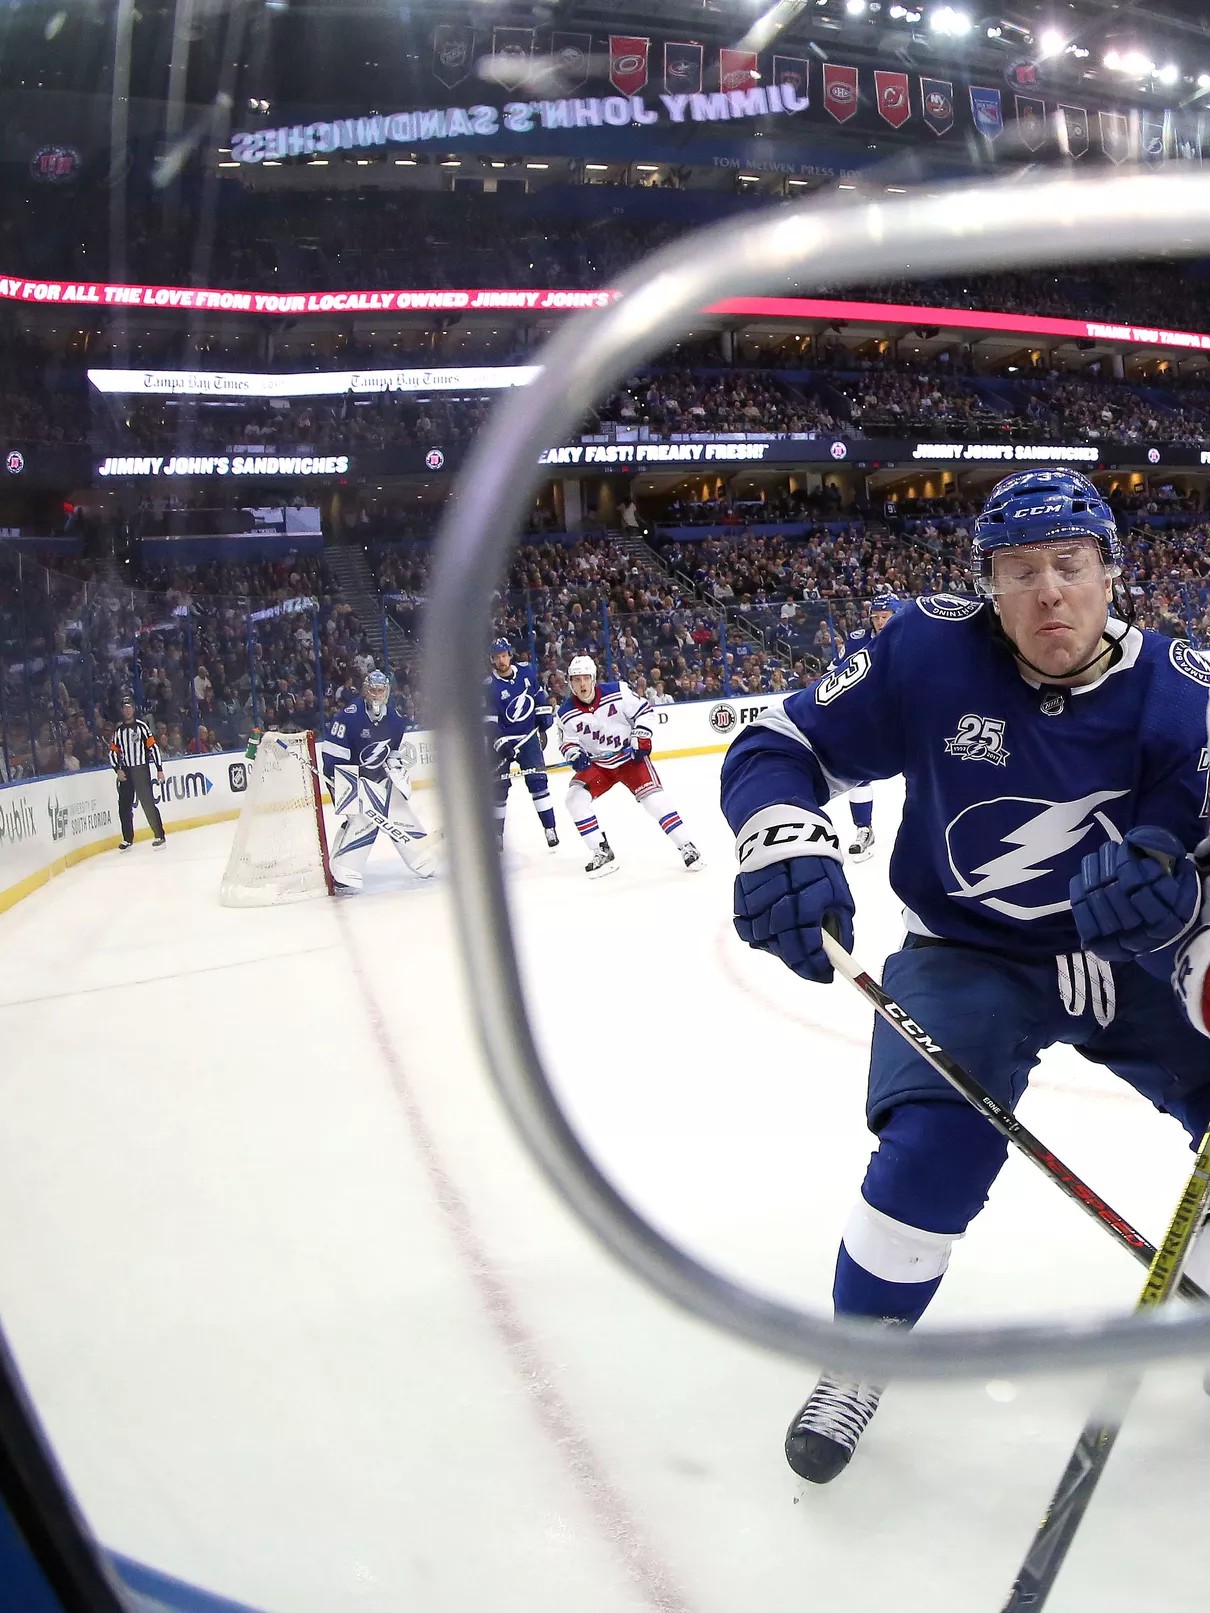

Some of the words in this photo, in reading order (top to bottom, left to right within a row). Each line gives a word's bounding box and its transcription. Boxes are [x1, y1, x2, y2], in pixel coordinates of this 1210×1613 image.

[713, 156, 741, 168] TOM
[801, 165, 835, 177] PRESS
[0, 278, 22, 297] AY
[22, 283, 61, 301] FOR
[61, 285, 99, 302] ALL
[103, 287, 141, 304] THE
[143, 289, 192, 307] LOVE
[195, 292, 250, 310] FROM
[254, 295, 306, 313] YOUR
[307, 294, 395, 311] LOCALLY
[396, 292, 469, 309] OWNED
[470, 292, 542, 308] JIMMY
[541, 291, 609, 308] JOHN'S
[1086, 323, 1131, 341] THANK
[1132, 327, 1159, 343] YOU
[1160, 331, 1200, 348] TAMPA
[142, 373, 185, 394] Tampa
[187, 373, 212, 392] Bay
[213, 375, 250, 391] Times
[350, 373, 393, 392] Tampa
[395, 373, 421, 390] Bay
[422, 373, 460, 388] Times
[538, 446, 584, 464] EAKY
[584, 444, 635, 463] FAST!
[636, 443, 704, 462] FREAKY
[704, 442, 769, 460] FRESH!
[912, 444, 962, 460] JIMMY
[963, 444, 1014, 460] JOHN'S
[1014, 443, 1099, 462] SANDWICHES
[99, 456, 164, 476] JIMMY
[163, 456, 230, 475] JOHN'S
[231, 455, 349, 475] SANDWICHES
[1013, 504, 1062, 519] CCM
[524, 678, 531, 688] A
[607, 703, 618, 718] A
[330, 721, 347, 739] 88
[955, 713, 1006, 753] 25
[150, 770, 208, 806] ctrum
[71, 817, 87, 836] SOUTH
[88, 809, 112, 831] FLORIDA
[365, 808, 411, 844] BAUER
[738, 821, 840, 865] CCM
[882, 1000, 944, 1055] CCM
[982, 1096, 1002, 1115] ERNE
